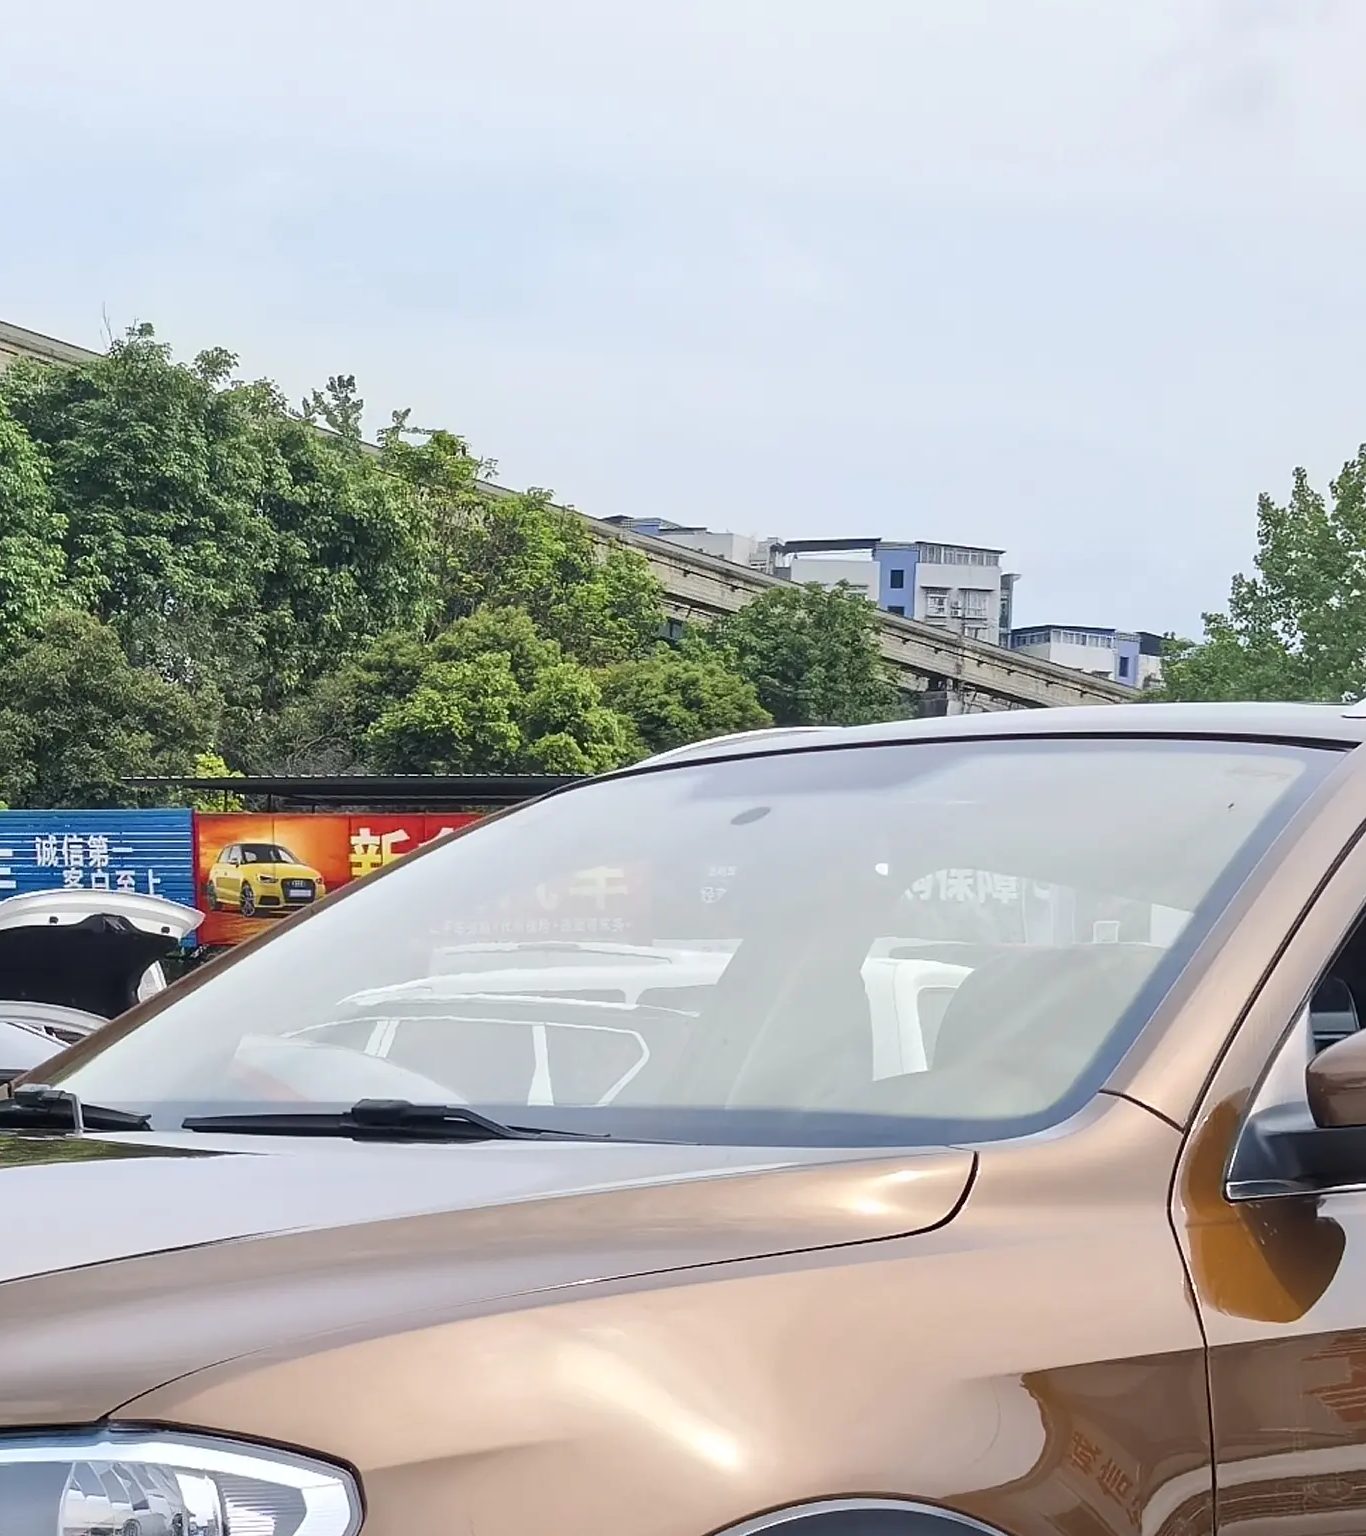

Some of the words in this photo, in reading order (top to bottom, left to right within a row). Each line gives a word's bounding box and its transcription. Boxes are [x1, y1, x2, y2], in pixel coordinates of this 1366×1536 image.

[35, 834, 134, 867] 诚信第一
[348, 827, 455, 878] 新
